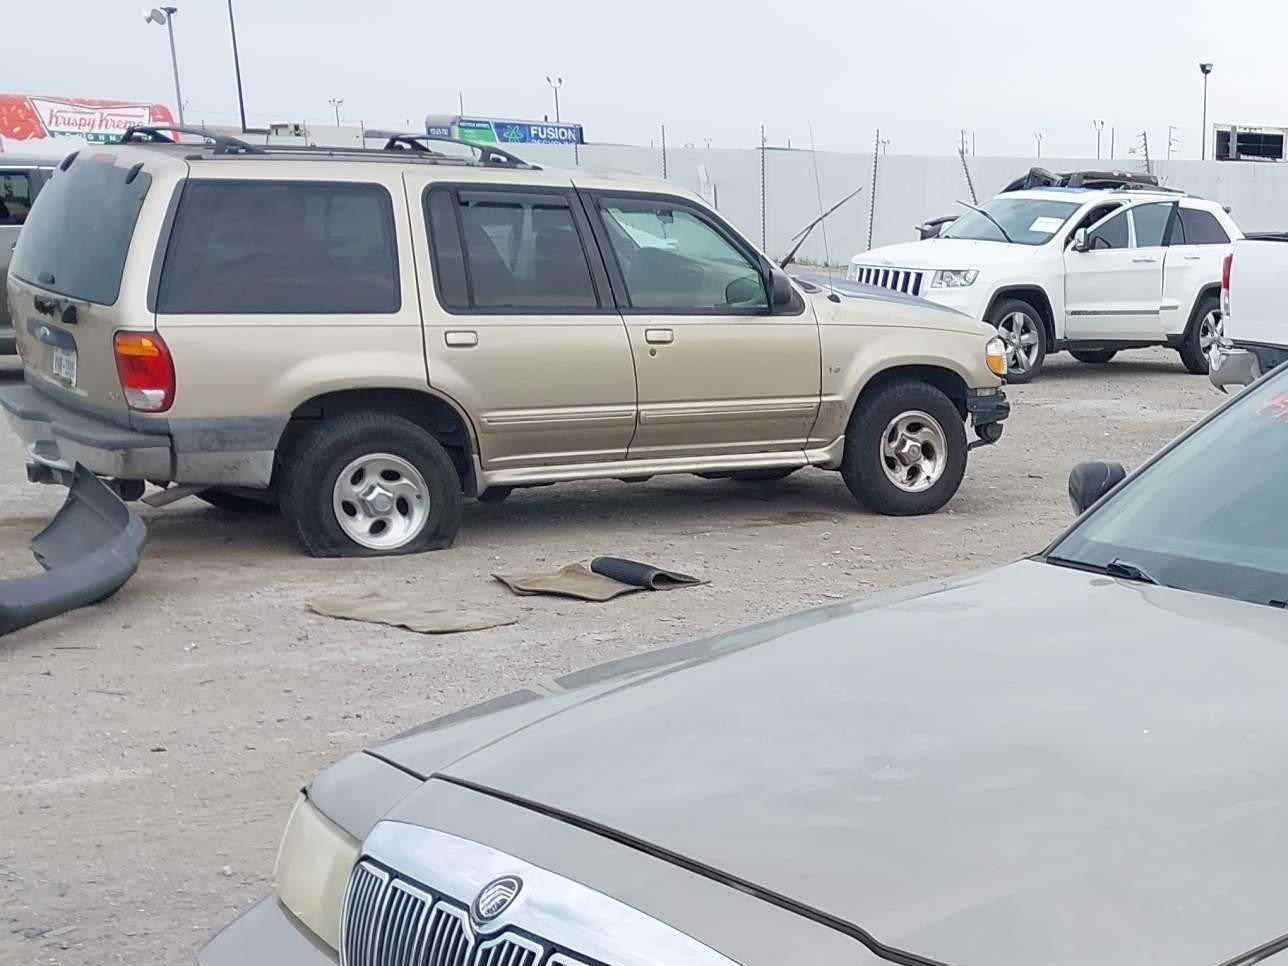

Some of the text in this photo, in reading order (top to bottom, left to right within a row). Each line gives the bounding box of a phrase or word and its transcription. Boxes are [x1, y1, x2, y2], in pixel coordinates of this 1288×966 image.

[48, 109, 144, 131] Krispy Kreme
[530, 126, 577, 141] FUSION
